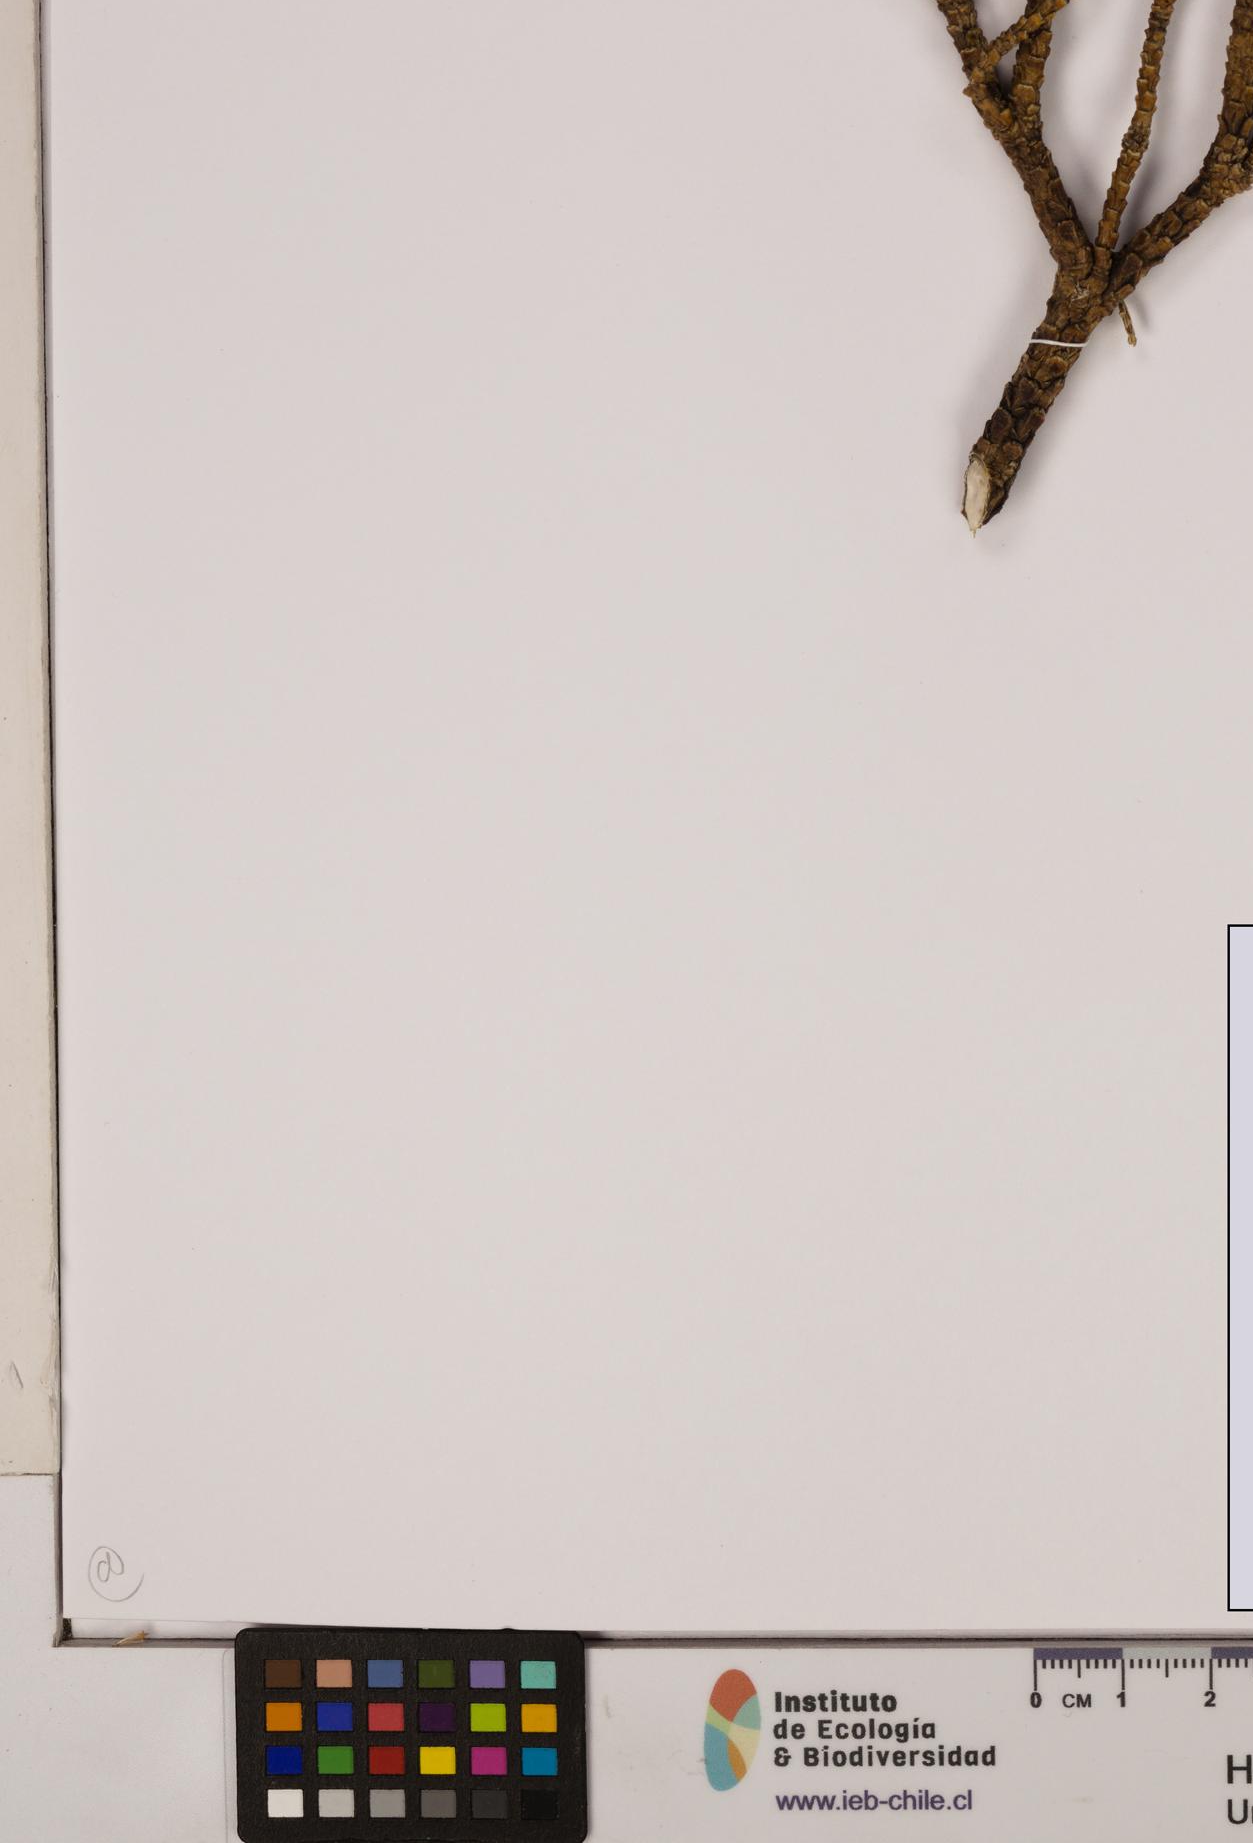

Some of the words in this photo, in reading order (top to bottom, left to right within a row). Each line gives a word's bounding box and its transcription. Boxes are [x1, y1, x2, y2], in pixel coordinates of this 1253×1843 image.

[774, 1689, 898, 1713] Instituto
[1029, 1691, 1043, 1709] 0
[1061, 1693, 1093, 1709] CM
[1115, 1691, 1127, 1708] 1
[1203, 1690, 1217, 1708] 2
[772, 1718, 806, 1740] de
[817, 1717, 936, 1743] Ecología
[773, 1746, 792, 1768] &
[803, 1744, 996, 1768] Biodiversidad
[775, 1788, 973, 1811] www.ieb-chile.cl
